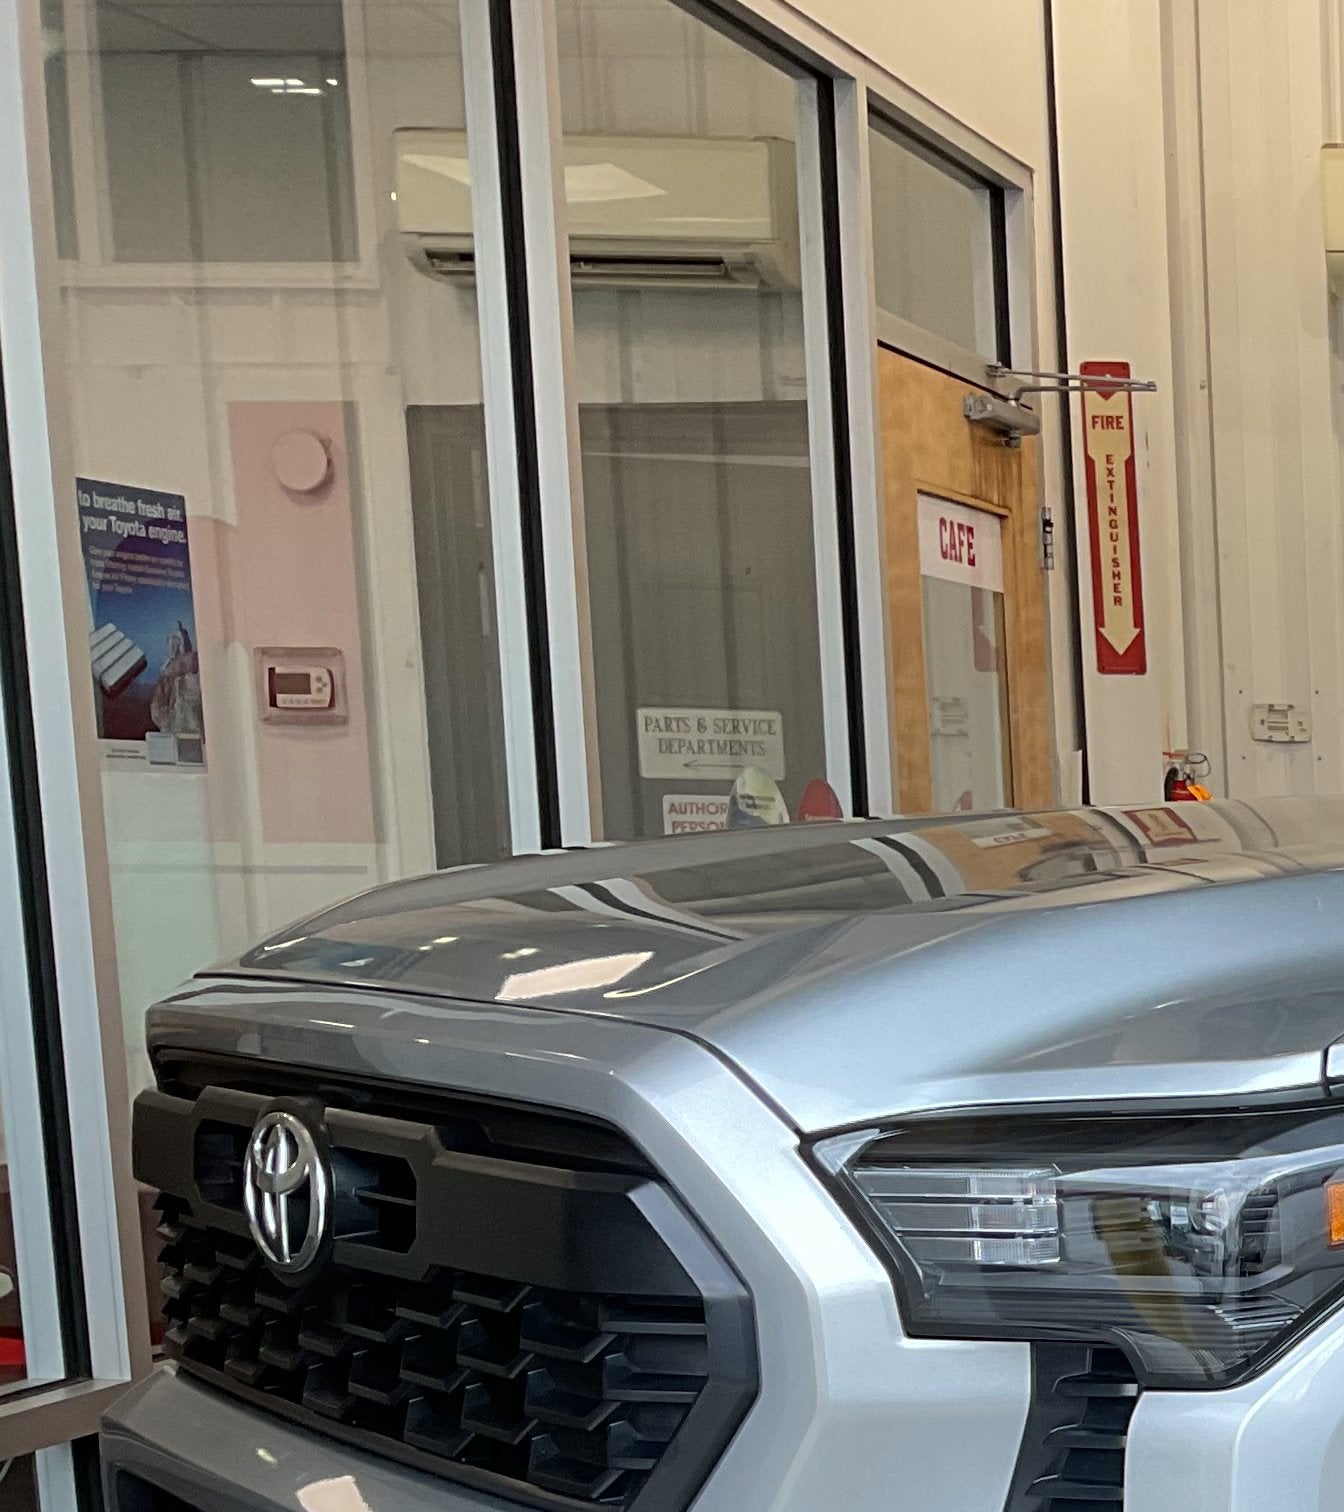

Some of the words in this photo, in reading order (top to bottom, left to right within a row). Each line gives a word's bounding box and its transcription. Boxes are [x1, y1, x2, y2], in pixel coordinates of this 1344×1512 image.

[1091, 415, 1124, 430] FIRE
[92, 491, 136, 514] breathe
[137, 499, 165, 519] fresh
[81, 516, 108, 532] your
[108, 516, 147, 538] Toyota
[1105, 454, 1123, 607] EXTINGUISHER
[939, 517, 976, 567] CAFE
[644, 716, 691, 733] PARTS
[713, 717, 777, 736] SERVICE
[658, 738, 766, 756] DEPARTMENTS
